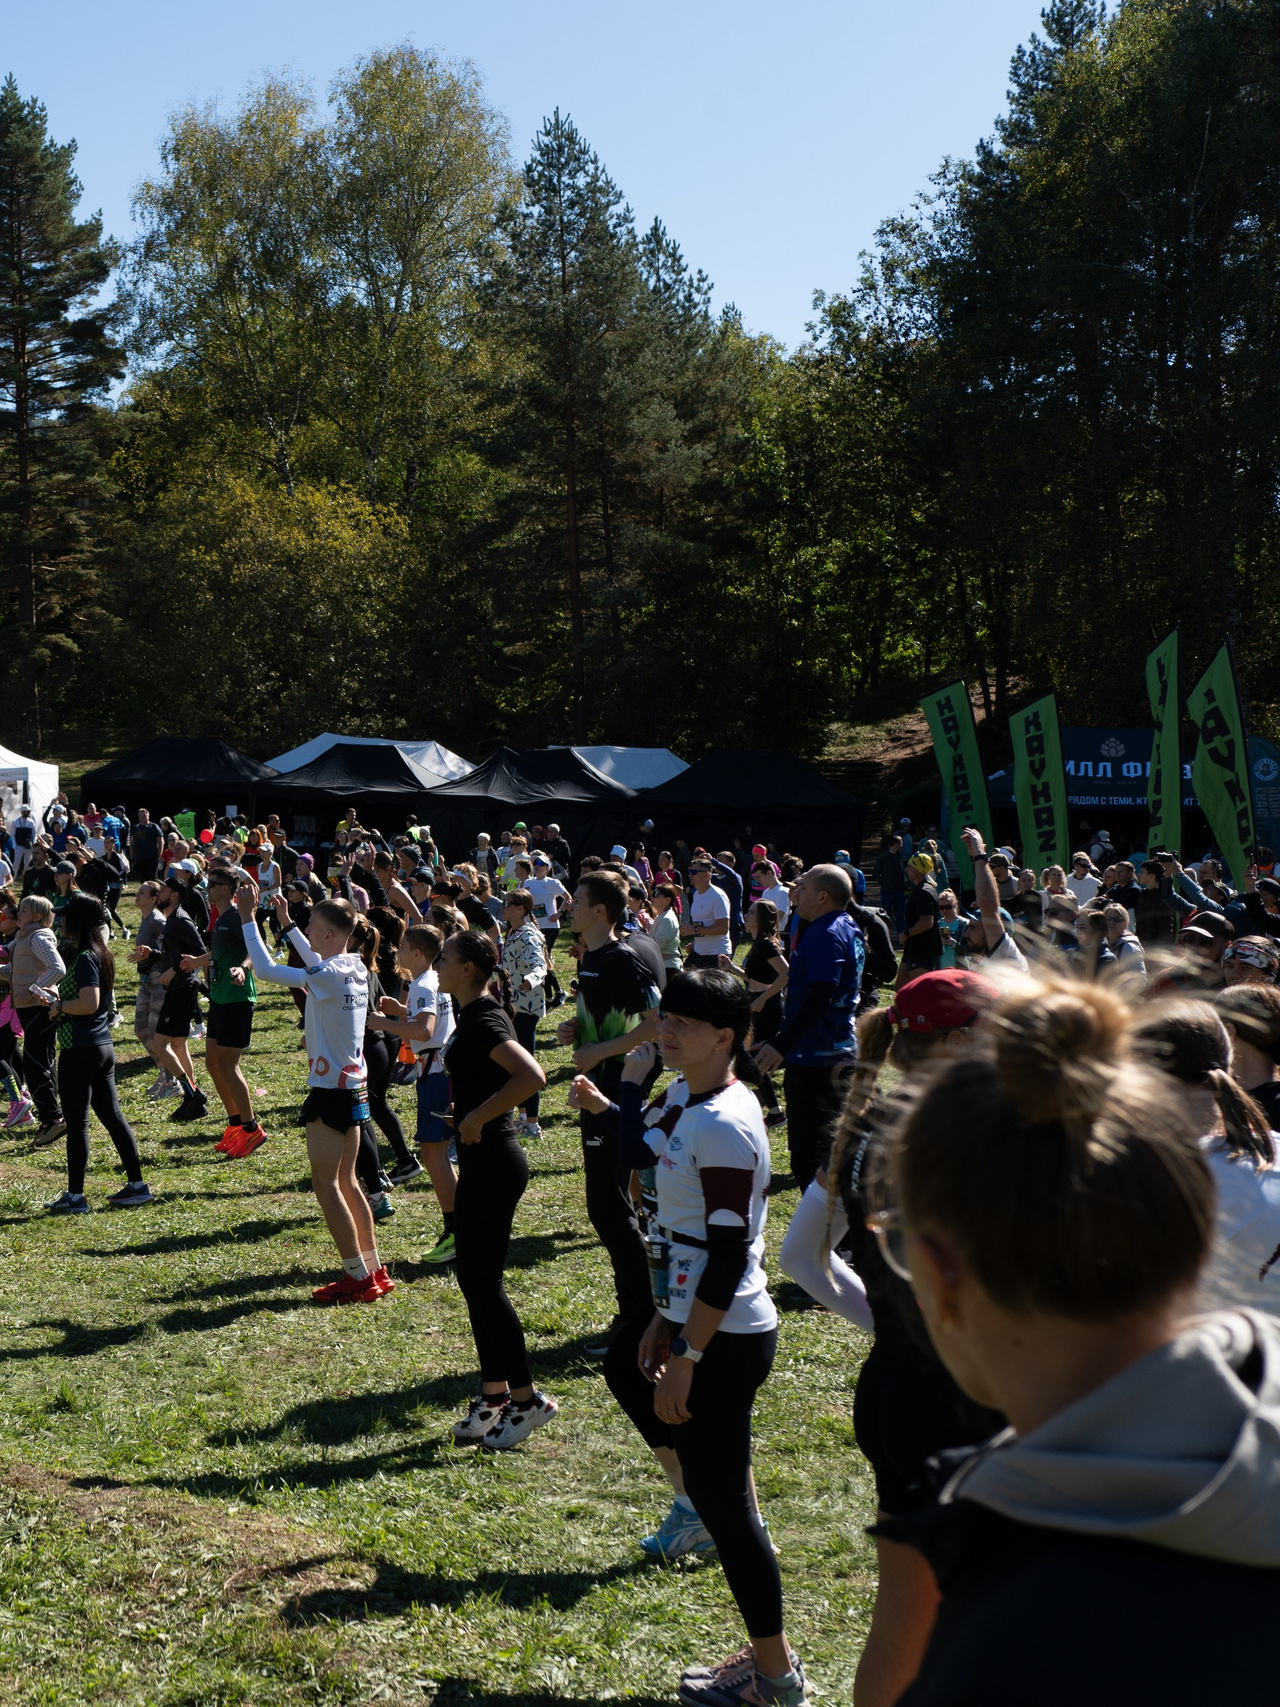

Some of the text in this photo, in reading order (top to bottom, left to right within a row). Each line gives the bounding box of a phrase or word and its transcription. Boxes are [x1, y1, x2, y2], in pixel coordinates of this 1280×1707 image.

[1065, 760, 1112, 777] ИЛЛ
[1201, 688, 1254, 858] AVKA
[1024, 710, 1057, 874] KAVKAZ.
[1068, 795, 1098, 805] РЯДОМ
[1136, 797, 1148, 805] КТ
[677, 1259, 692, 1271] WE
[668, 1287, 687, 1299] NING
